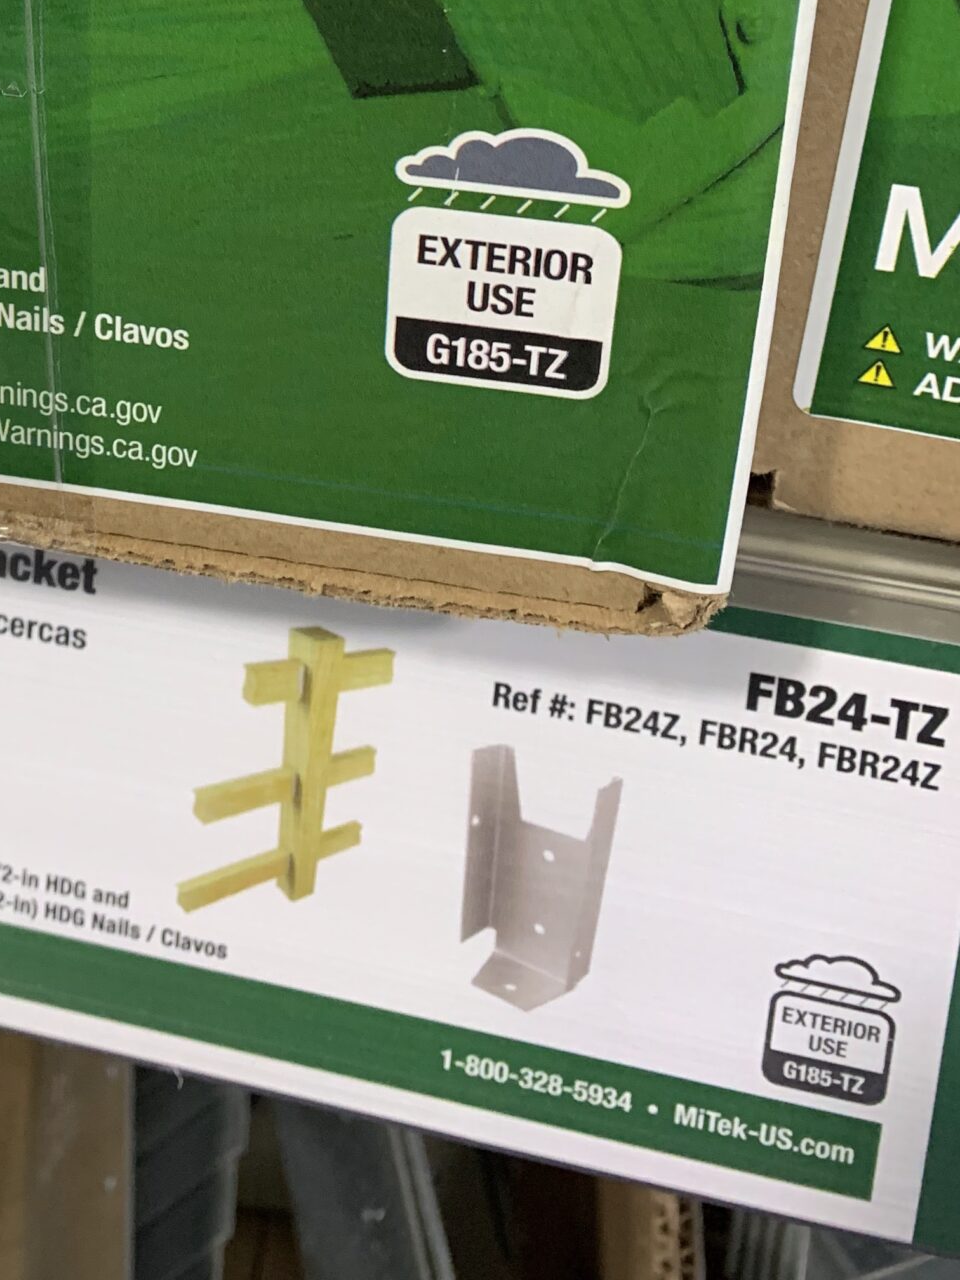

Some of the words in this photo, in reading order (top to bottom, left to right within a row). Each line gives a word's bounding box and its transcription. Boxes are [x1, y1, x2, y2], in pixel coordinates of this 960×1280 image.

[417, 234, 594, 285] EXTERIOR
[467, 281, 536, 318] USE
[94, 313, 190, 351] Clavos
[426, 333, 569, 380] G185-TZ
[746, 671, 950, 748] FB24-TZ
[493, 681, 541, 716] Ref
[548, 691, 576, 722] #:
[586, 697, 688, 748] FB24Z,
[698, 718, 807, 771] FBR24,
[817, 742, 943, 793] FBR24Z
[45, 873, 87, 900] HDG
[92, 887, 130, 909] and
[44, 902, 86, 927] HDG
[91, 913, 140, 940] Nails
[160, 928, 229, 960] Clavos
[781, 1005, 882, 1045] EXTERIOR
[808, 1033, 849, 1059] USE
[782, 1061, 867, 1097] G185-TZ
[440, 1048, 633, 1113] 1-800-328-5934
[673, 1102, 856, 1166] MiTek-US.com
